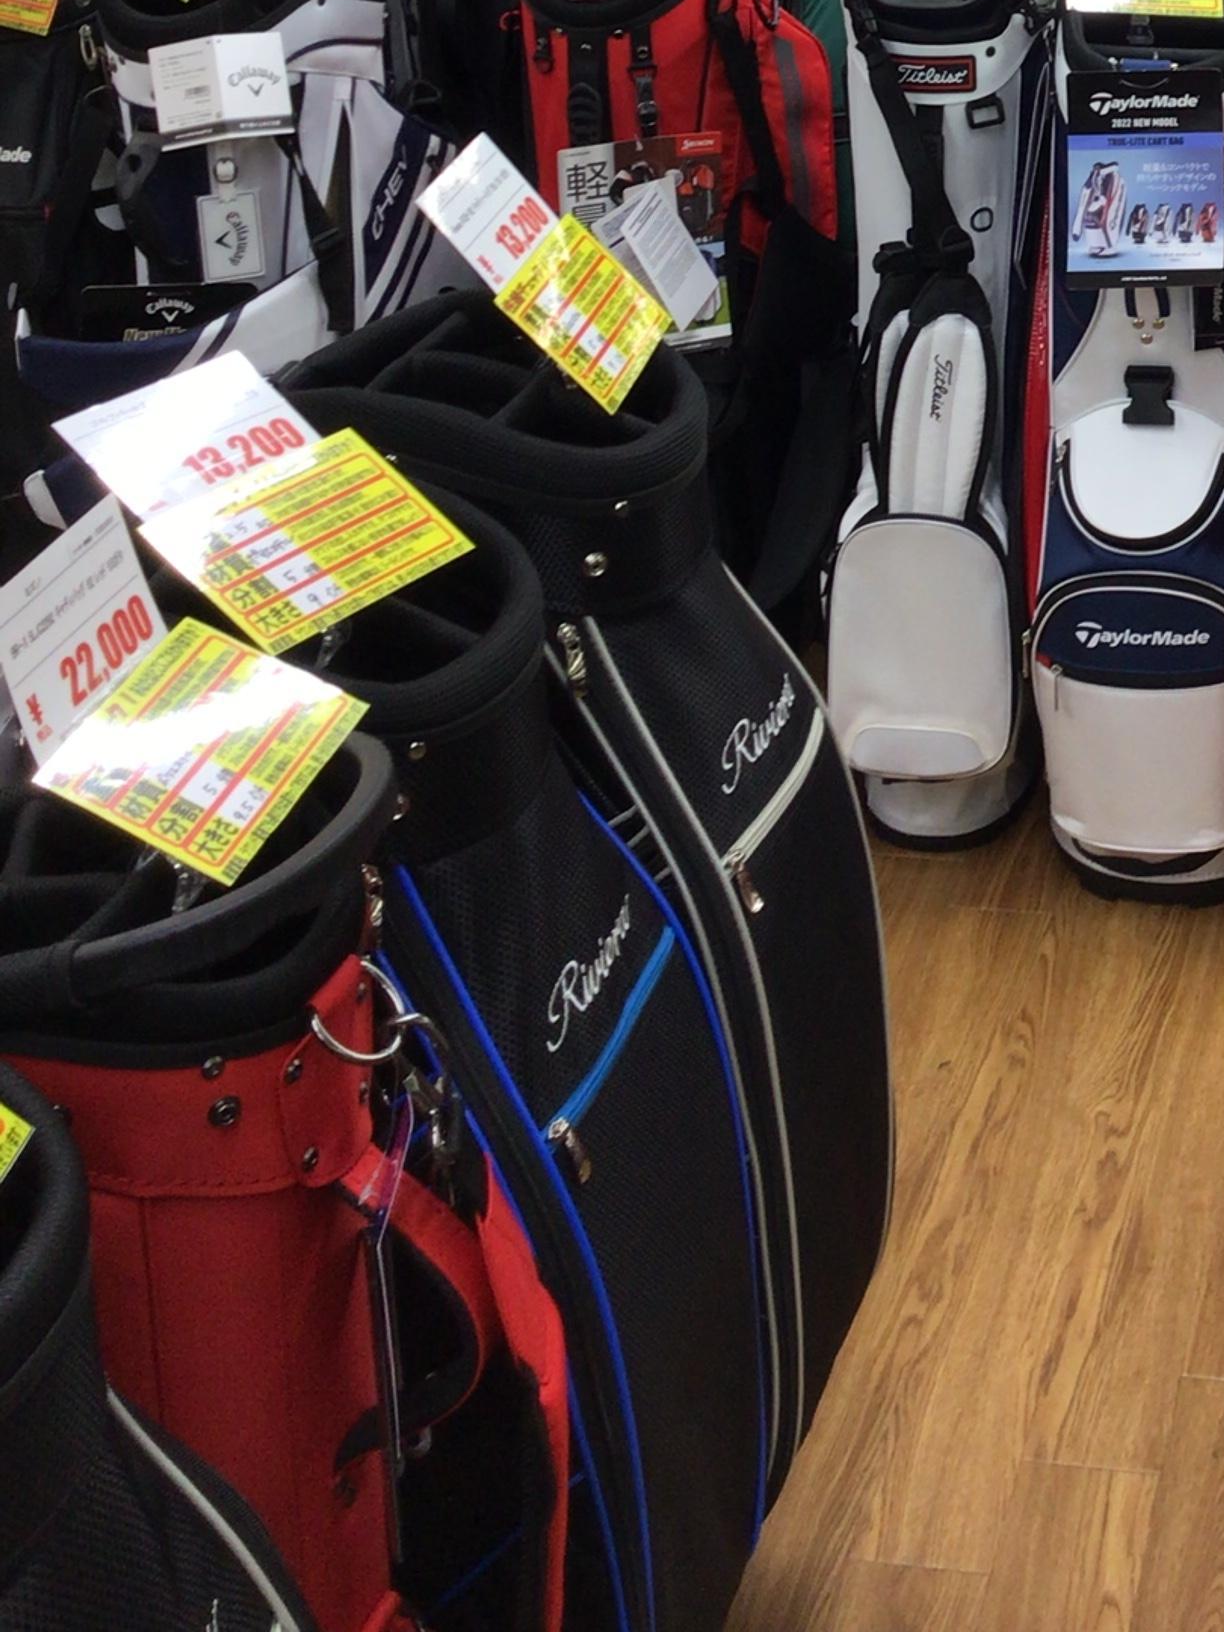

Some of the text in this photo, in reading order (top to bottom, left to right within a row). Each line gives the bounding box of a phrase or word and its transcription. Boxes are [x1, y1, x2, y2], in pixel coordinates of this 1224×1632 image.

[227, 66, 281, 86] Callaway
[898, 64, 967, 84] Titleist
[1089, 92, 1199, 116] TaylorMade
[1112, 117, 1179, 128] 2022 NEW MODEL
[227, 211, 249, 267] Callaway
[496, 196, 550, 261] 13,200
[144, 298, 194, 315] Callaway
[929, 353, 954, 421] Titleist
[181, 416, 307, 486] 13,200
[1075, 621, 1210, 649] TaylorMade
[60, 594, 154, 707] 22,000
